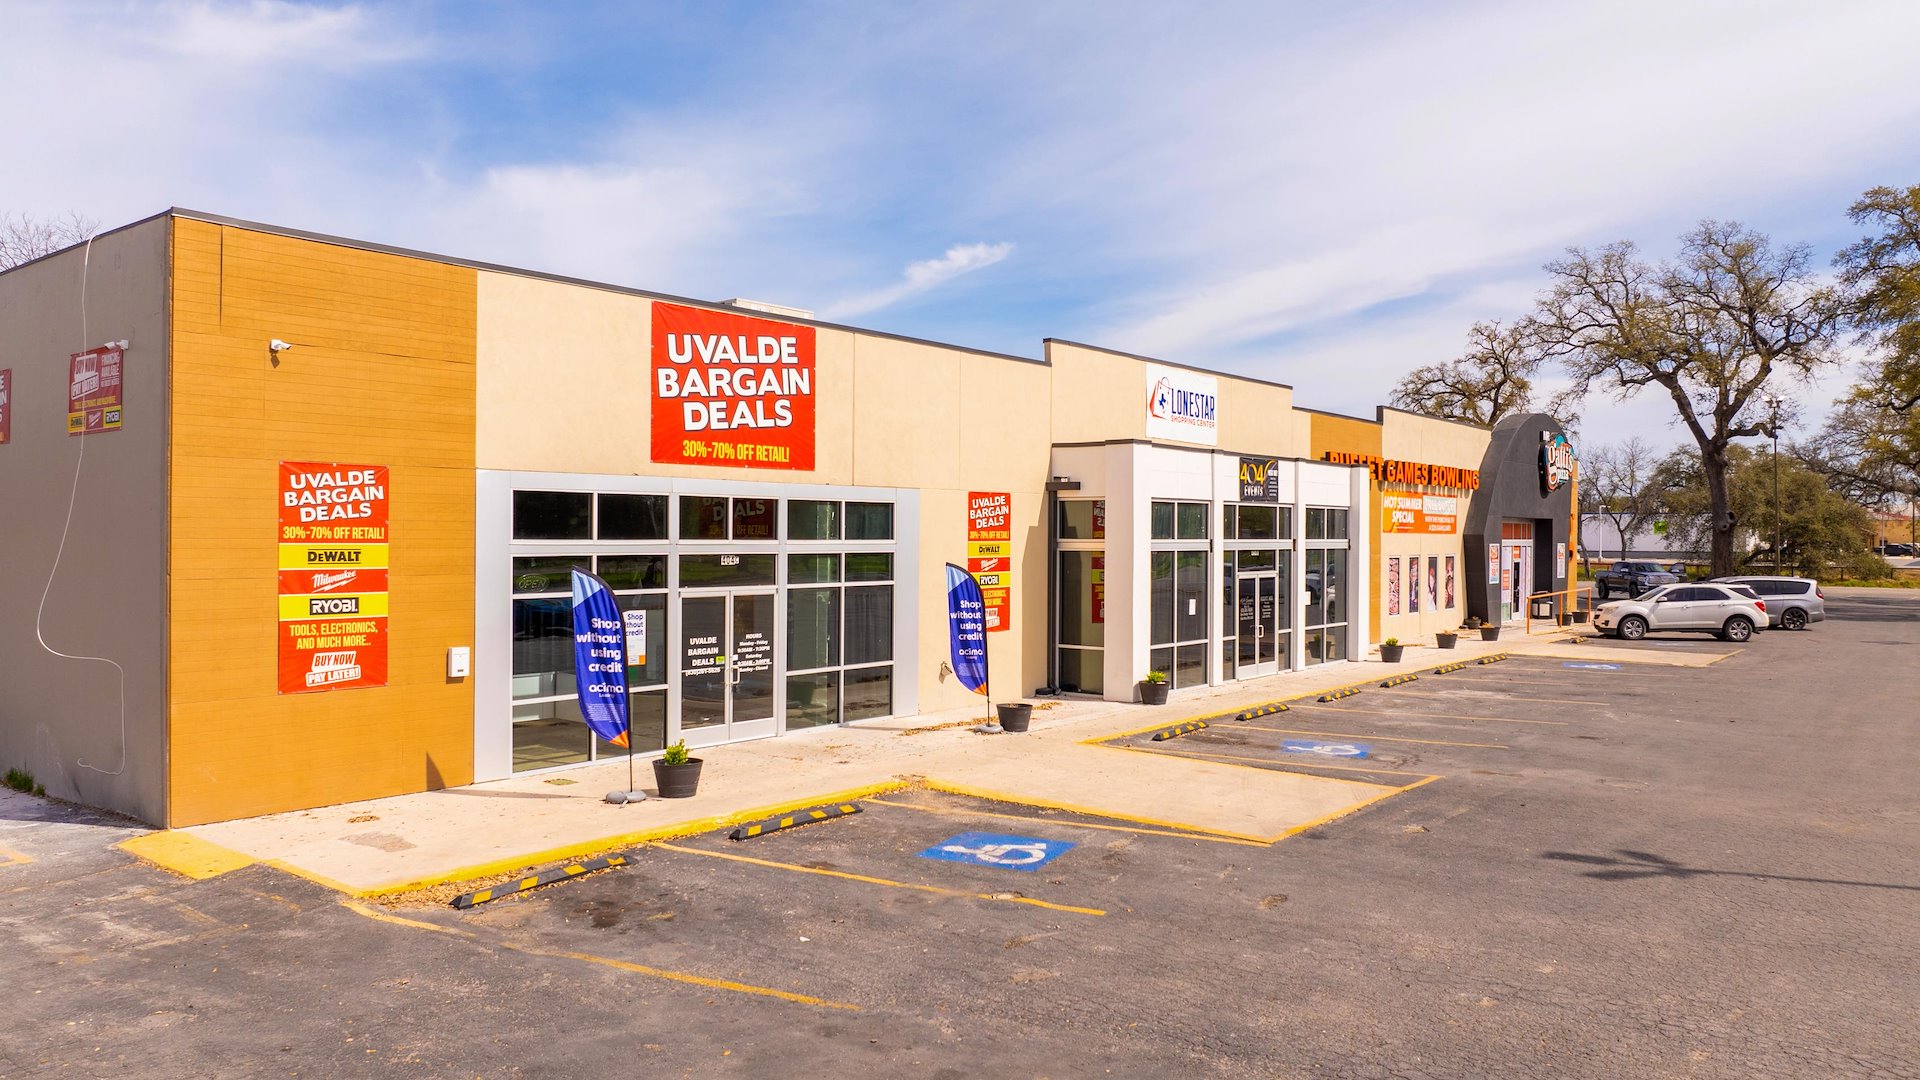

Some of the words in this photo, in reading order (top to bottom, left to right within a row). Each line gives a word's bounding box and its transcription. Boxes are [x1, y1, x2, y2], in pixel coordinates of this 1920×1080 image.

[667, 333, 798, 364] UVALDE
[657, 367, 810, 398] BARGAIN
[1171, 388, 1215, 421] LONESTAR
[682, 399, 793, 431] DEALS
[1171, 415, 1196, 426] SHOPPING
[1196, 420, 1215, 429] CENTER
[683, 440, 735, 459] 30%-70%
[737, 444, 753, 460] OFF
[756, 445, 790, 462] RETAIL!
[290, 470, 376, 489] UVALDE
[1240, 463, 1264, 485] 404
[1386, 459, 1429, 486] GAMES
[1431, 465, 1480, 491] BOWLING
[284, 485, 384, 507] BARGAIN
[1244, 485, 1264, 497] EVENTS
[972, 495, 1005, 508] UVALDE
[1384, 496, 1397, 509] HOT
[1397, 497, 1422, 511] SUMMER
[300, 502, 372, 523] DEALS
[713, 500, 766, 521] DALS
[970, 505, 1009, 519] BARGAIN
[1392, 511, 1414, 524] SPECIAL
[976, 516, 1004, 529] DEALS
[283, 526, 332, 539] 30%-70%
[333, 527, 350, 539] OFF
[352, 527, 385, 539] RETAIL!
[311, 569, 357, 588] Milwaukee
[960, 600, 981, 609] Shop
[627, 612, 644, 621] Shop
[950, 611, 981, 619] without
[289, 624, 320, 637] TOOLS,
[321, 621, 378, 635] ELECTRONICS,
[591, 618, 621, 631] Shop
[960, 622, 982, 631] using
[296, 638, 315, 650] AND
[316, 636, 341, 649] MUCH
[576, 632, 621, 643] without
[689, 636, 717, 645] UVALDE
[958, 632, 983, 640] credit
[590, 647, 621, 660] using
[687, 647, 719, 656] BARGAIN
[314, 655, 332, 667] BUY
[333, 653, 355, 666] NOW
[691, 657, 715, 666] DEALS
[588, 663, 623, 673] credit
[309, 671, 326, 684] PAY
[327, 667, 359, 681] LATER!
[588, 682, 624, 693] acima
